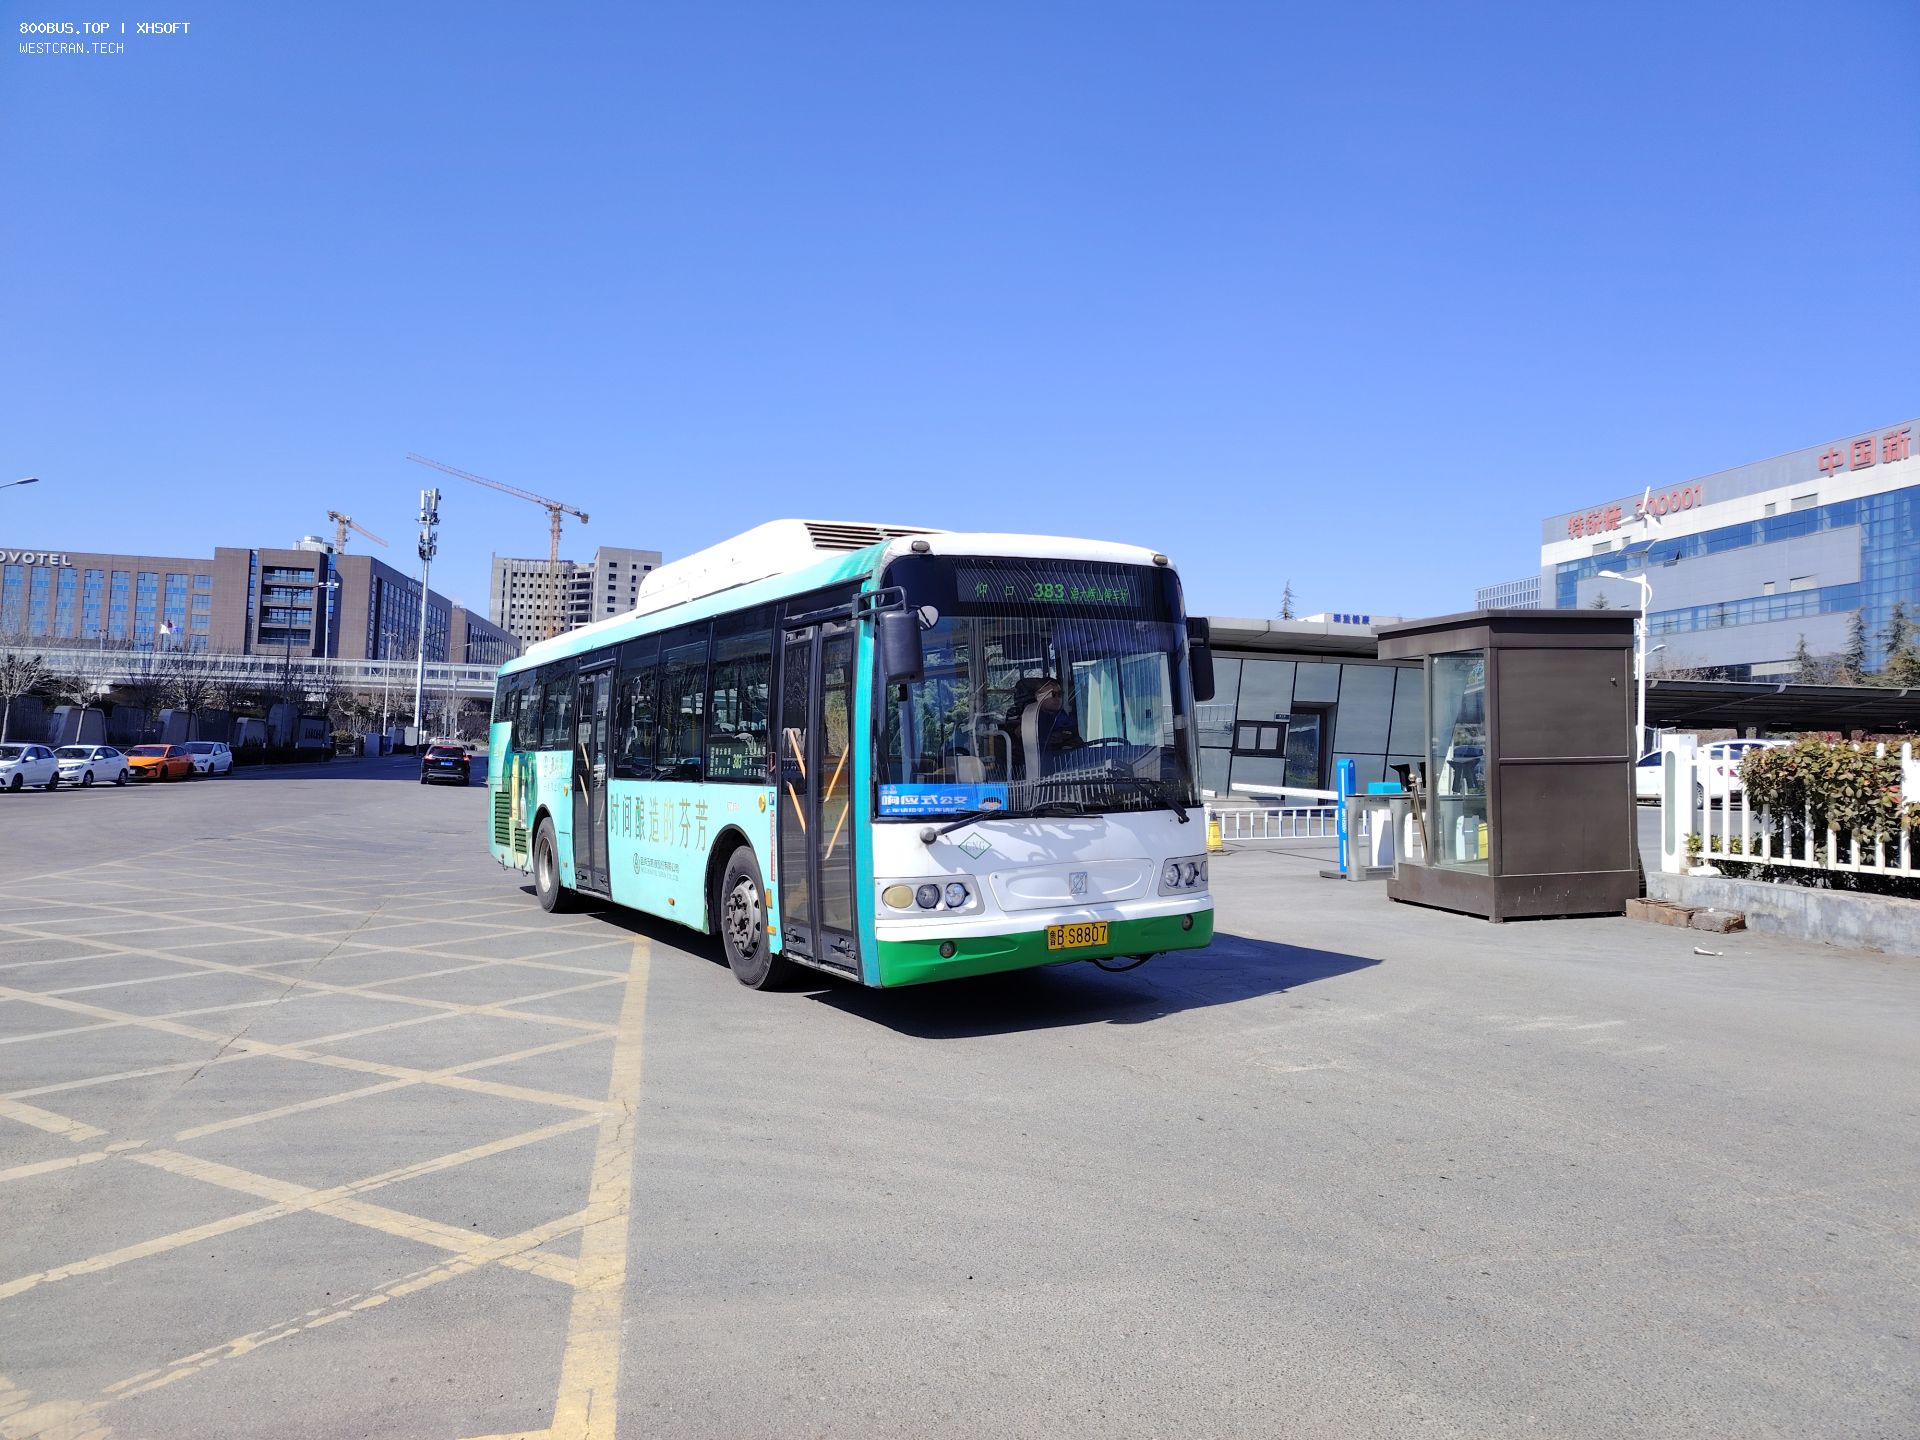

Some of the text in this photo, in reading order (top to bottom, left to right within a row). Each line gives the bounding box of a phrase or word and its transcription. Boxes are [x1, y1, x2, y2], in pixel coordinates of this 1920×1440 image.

[1817, 426, 1920, 478] 中国新
[1033, 582, 1065, 600] 383
[610, 793, 709, 852] 时间酿造的芬芳
